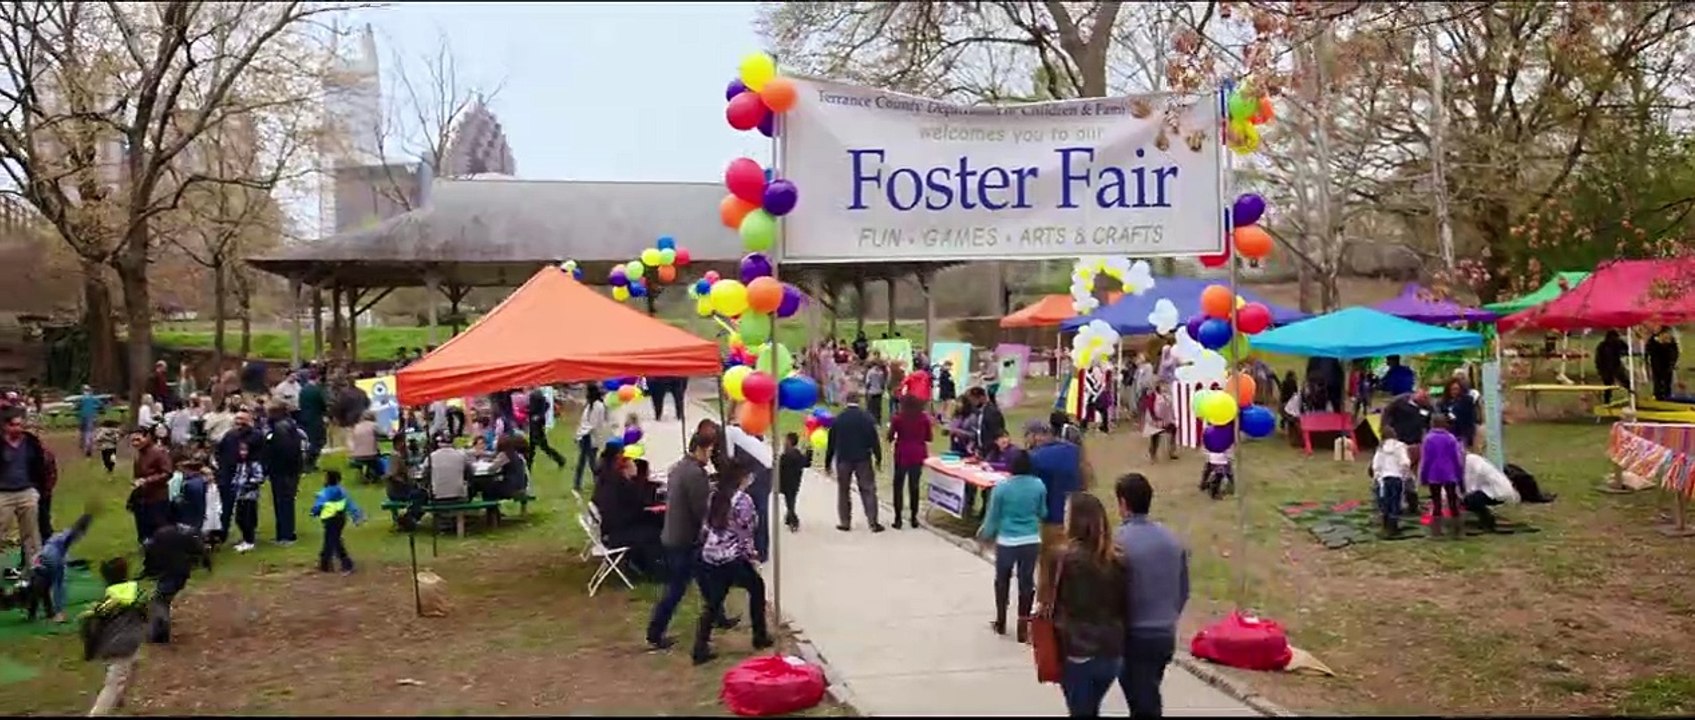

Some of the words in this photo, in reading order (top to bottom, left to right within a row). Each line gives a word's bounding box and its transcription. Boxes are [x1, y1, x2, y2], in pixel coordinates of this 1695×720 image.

[817, 90, 871, 107] Terrance
[875, 95, 922, 112] County
[927, 101, 1001, 117] Departt
[1021, 102, 1078, 116] Children
[1081, 102, 1092, 116] &
[919, 124, 1004, 141] welcomes
[1013, 128, 1043, 144] you
[1051, 126, 1069, 141] to
[1076, 127, 1104, 141] our
[847, 149, 1039, 211] Foster
[1054, 147, 1178, 208] Fair
[858, 228, 901, 247] FUN
[923, 227, 998, 247] GAMES
[1020, 226, 1065, 245] ARTS
[1074, 227, 1086, 245] &
[1092, 224, 1163, 245] CRAFTS
